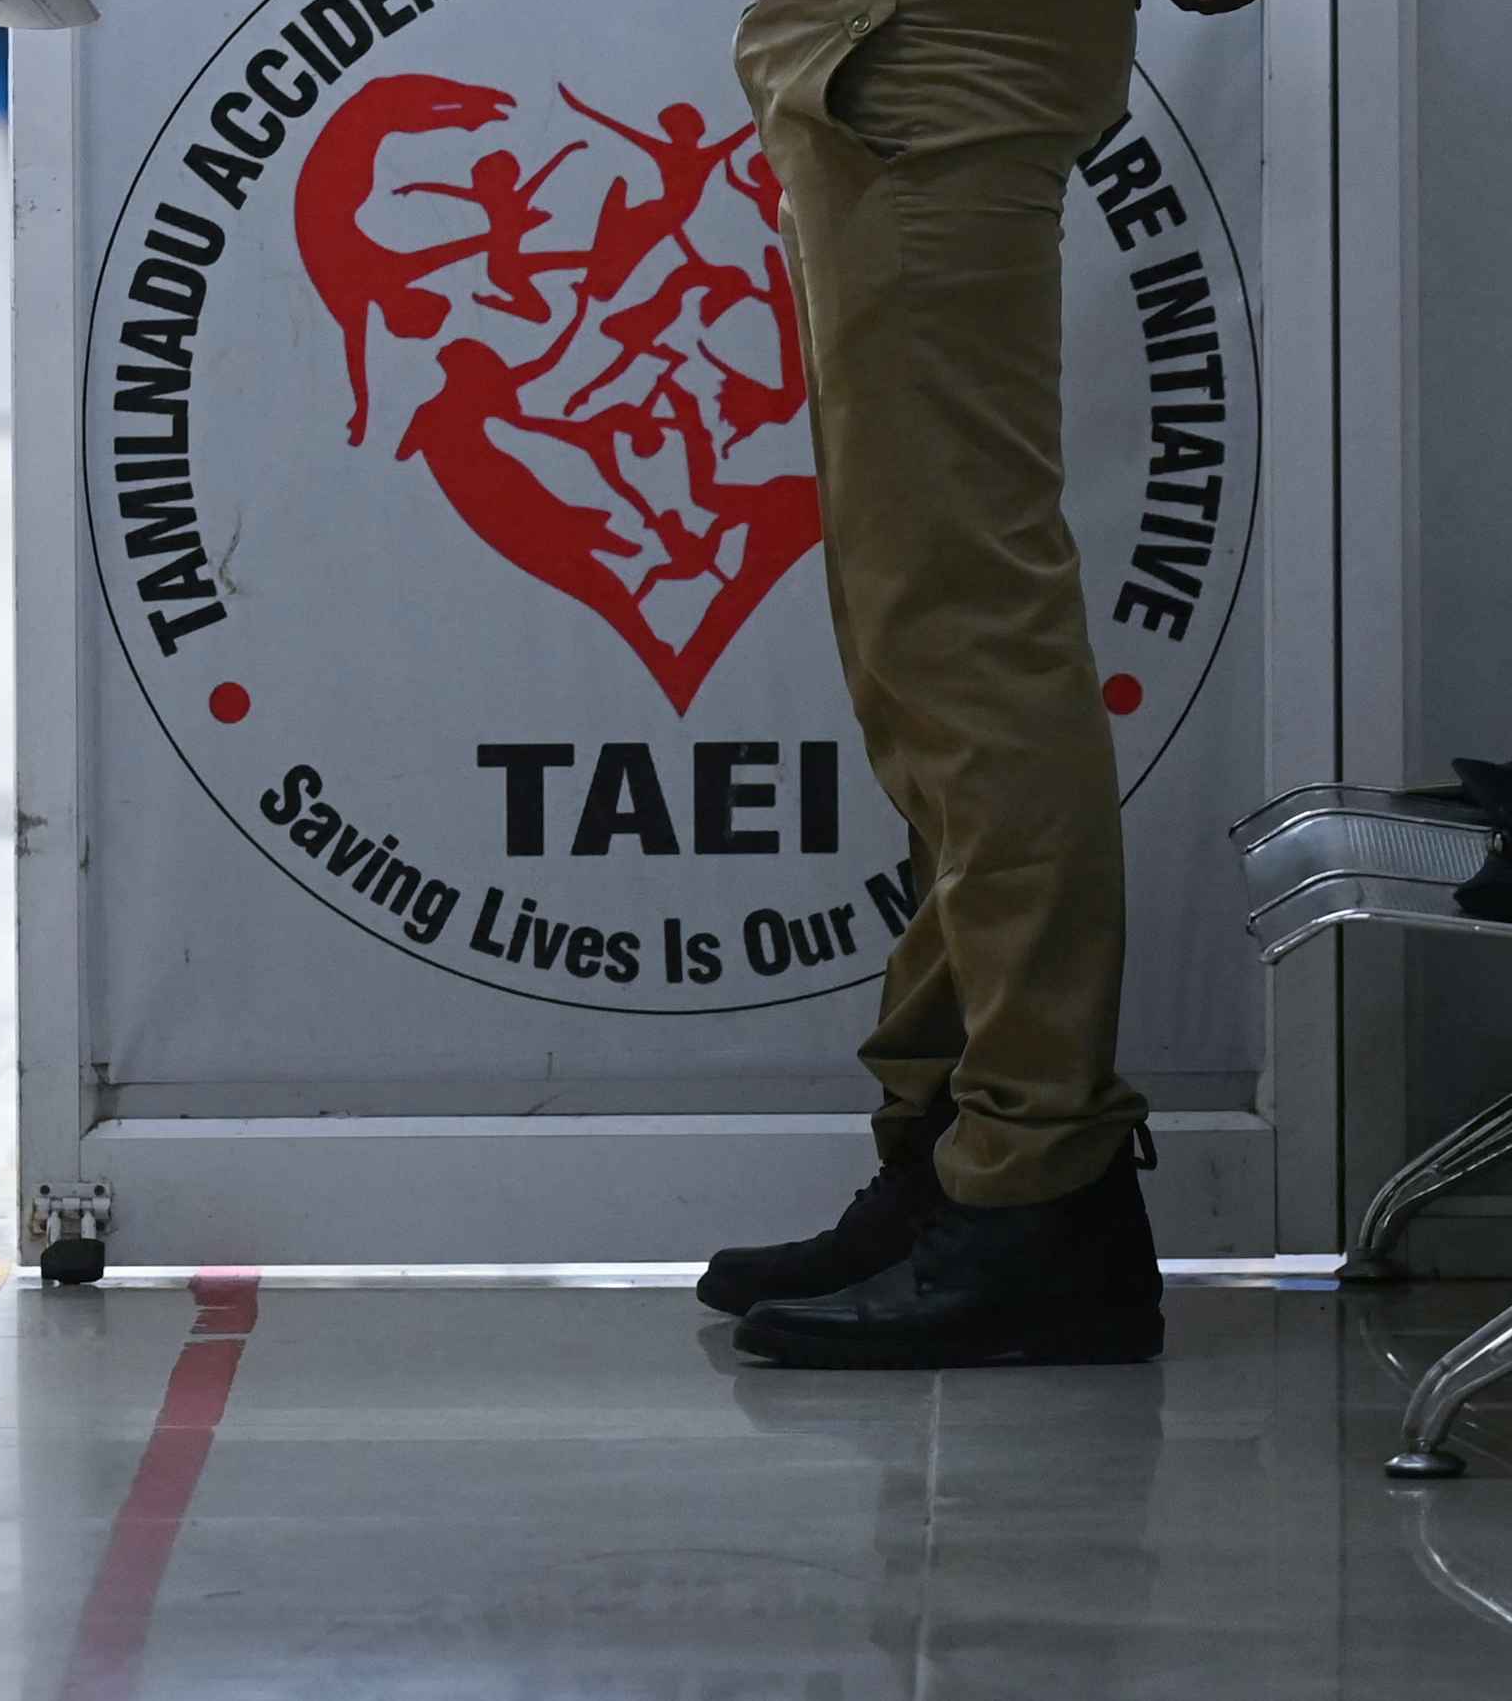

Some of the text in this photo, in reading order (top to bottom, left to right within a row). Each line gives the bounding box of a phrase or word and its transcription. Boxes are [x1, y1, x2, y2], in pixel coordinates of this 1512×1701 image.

[113, 202, 227, 657] TAMILNADU
[1112, 250, 1226, 643] INITIATIVE
[259, 764, 462, 946] Saving
[469, 886, 641, 984] Lives
[663, 917, 724, 985] Is
[743, 902, 857, 977] Our
[476, 740, 839, 857] TAEI
